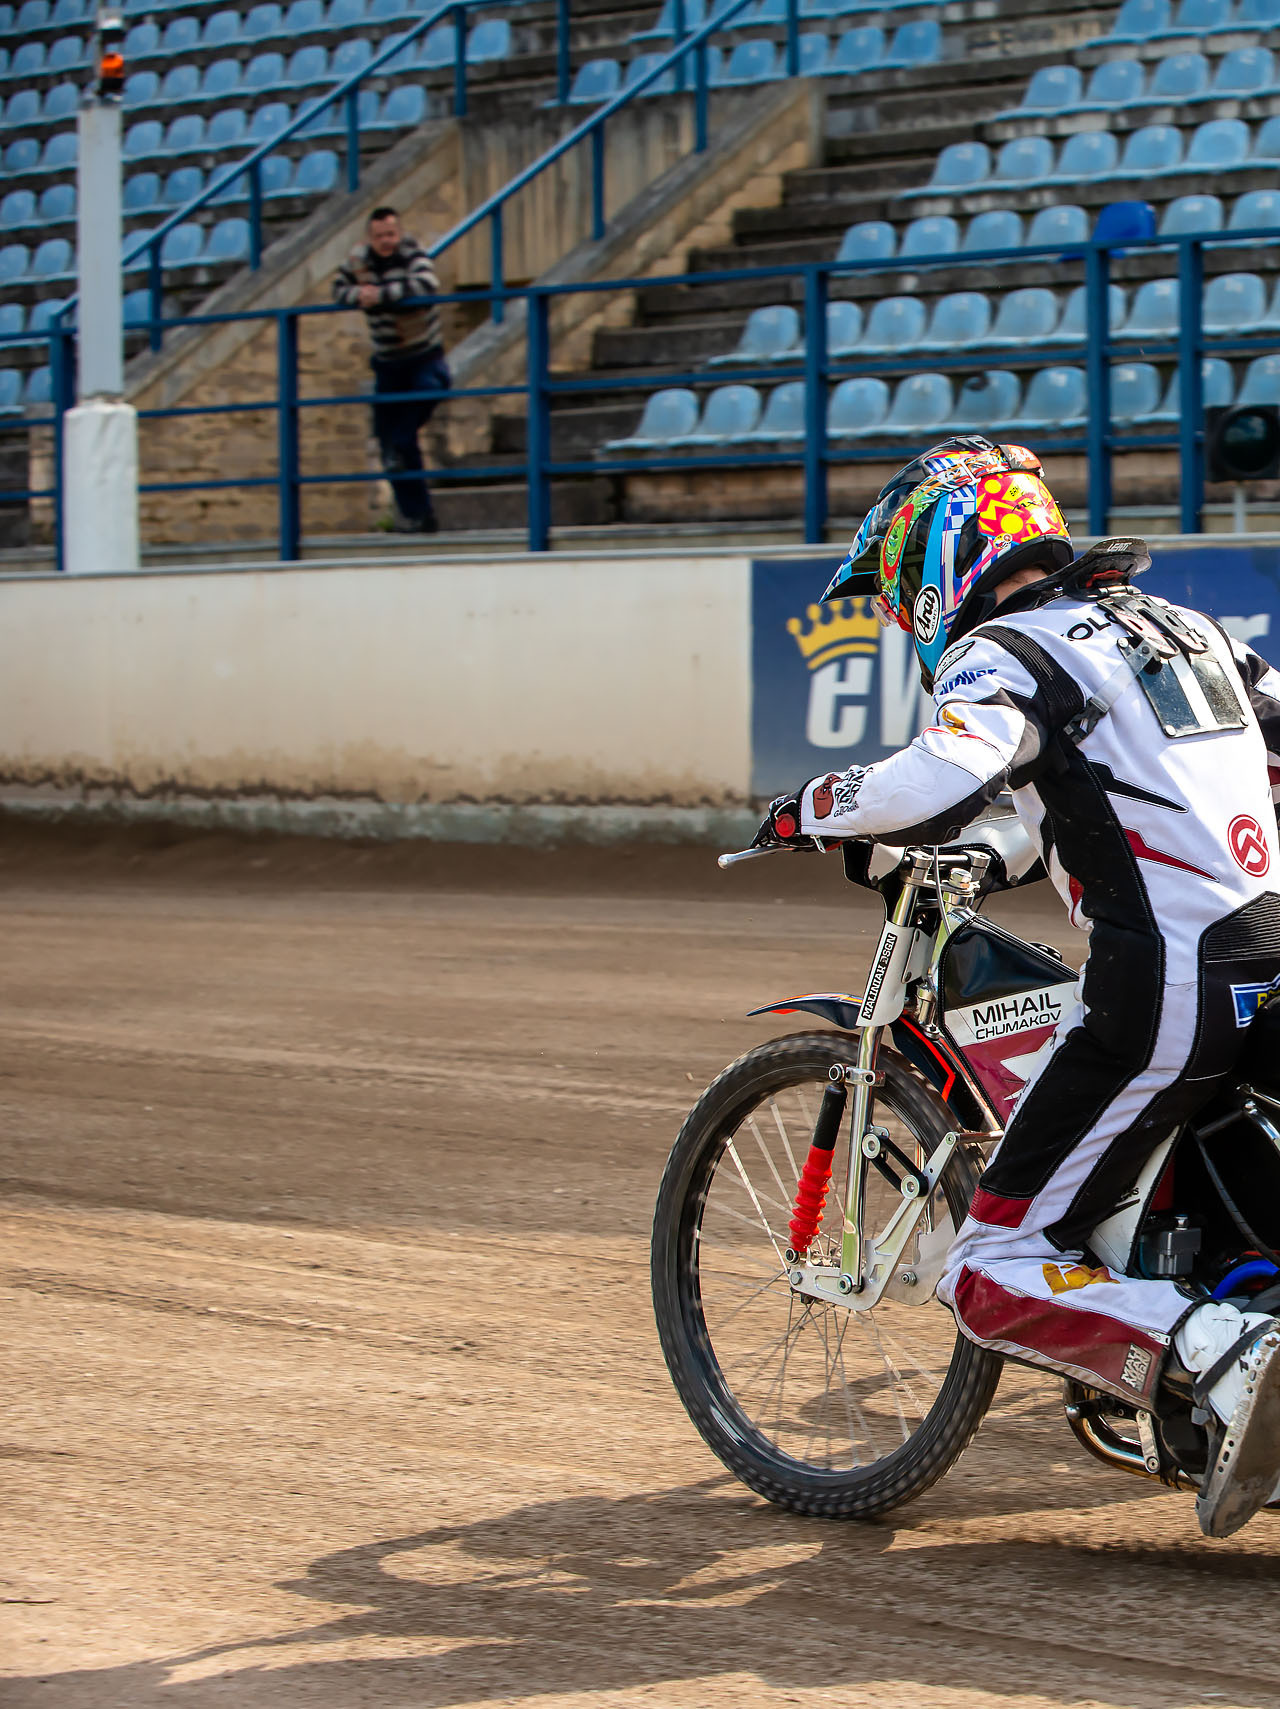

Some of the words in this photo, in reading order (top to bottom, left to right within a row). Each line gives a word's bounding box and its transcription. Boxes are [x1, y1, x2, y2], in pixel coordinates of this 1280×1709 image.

[917, 591, 937, 642] Arai
[972, 993, 1062, 1027] MIHAIL
[975, 1010, 1062, 1041] CHUMAKOV
